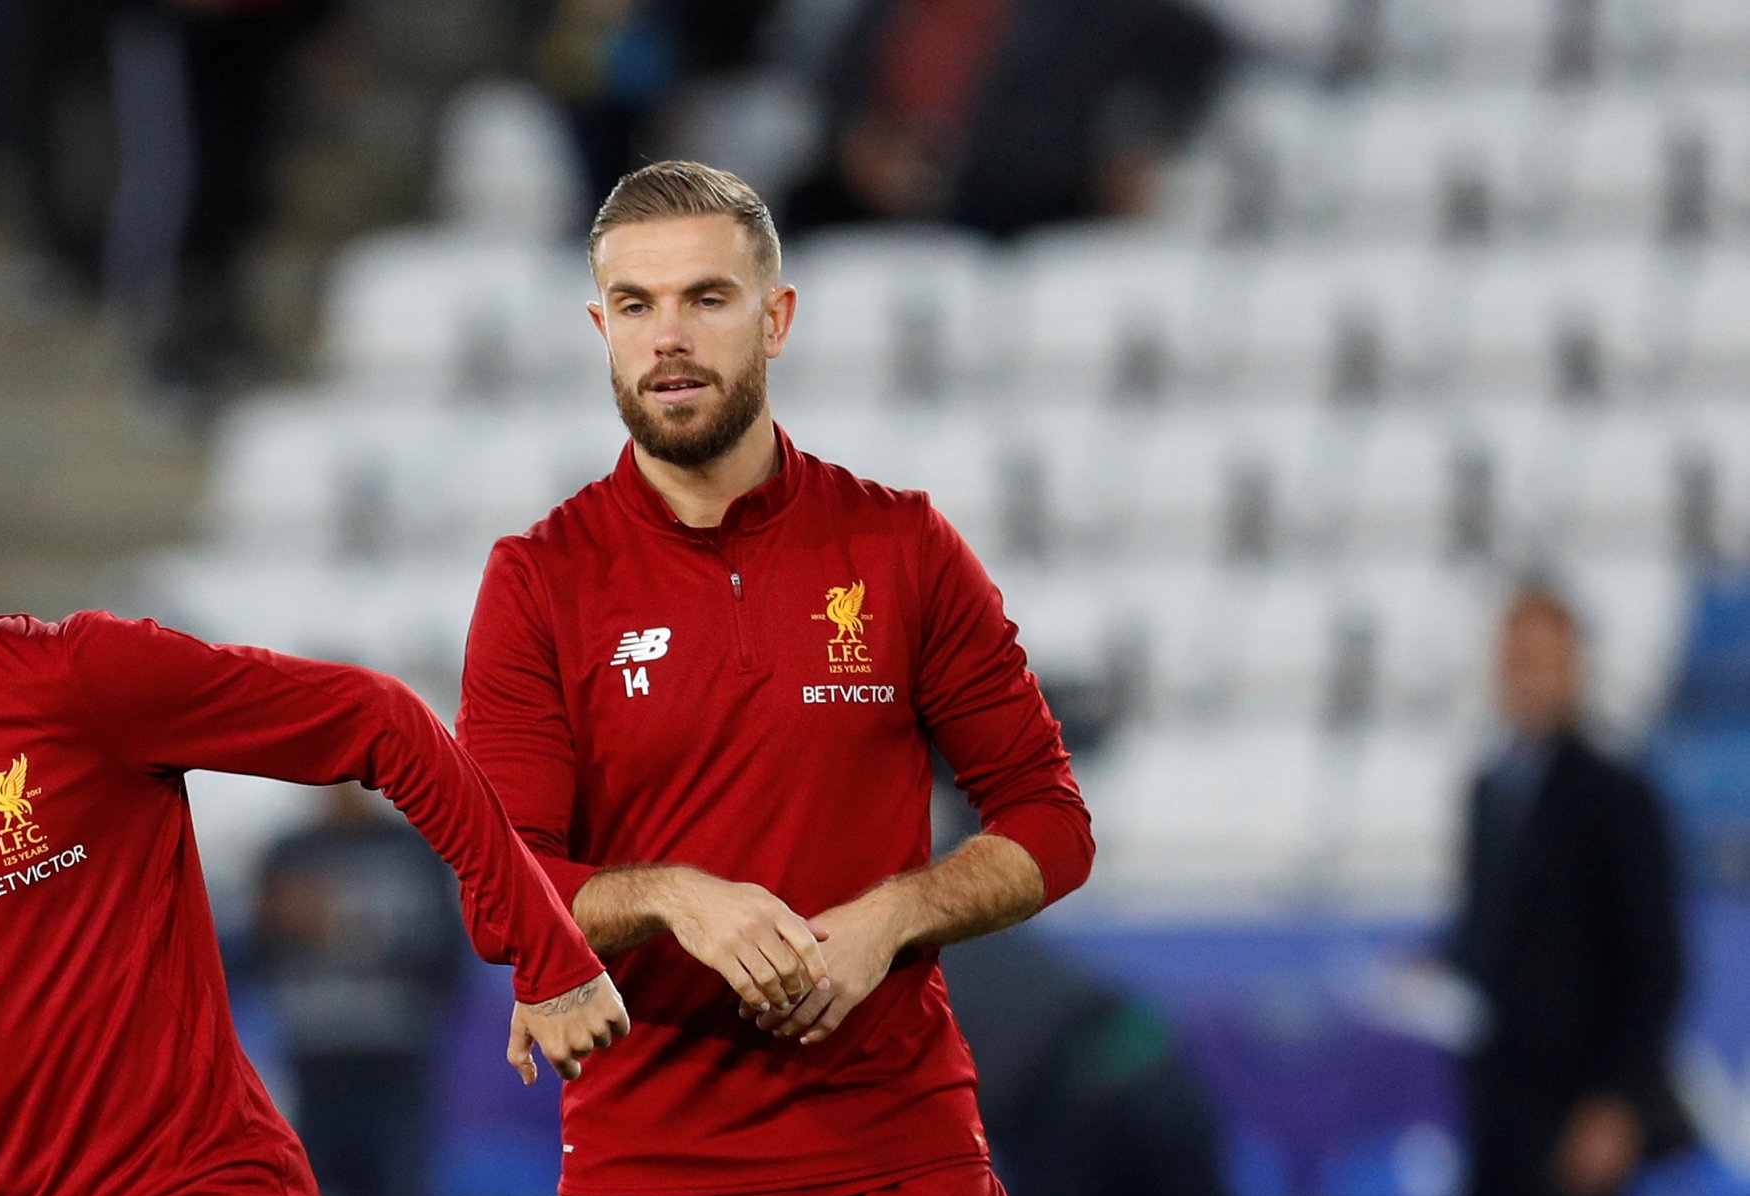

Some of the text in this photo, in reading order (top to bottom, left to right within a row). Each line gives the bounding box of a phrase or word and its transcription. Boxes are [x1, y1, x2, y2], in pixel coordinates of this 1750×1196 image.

[844, 665, 872, 674] YEARS
[622, 666, 650, 698] 14
[802, 685, 895, 704] BETVICTOR
[3, 843, 49, 867] 125 YEARS
